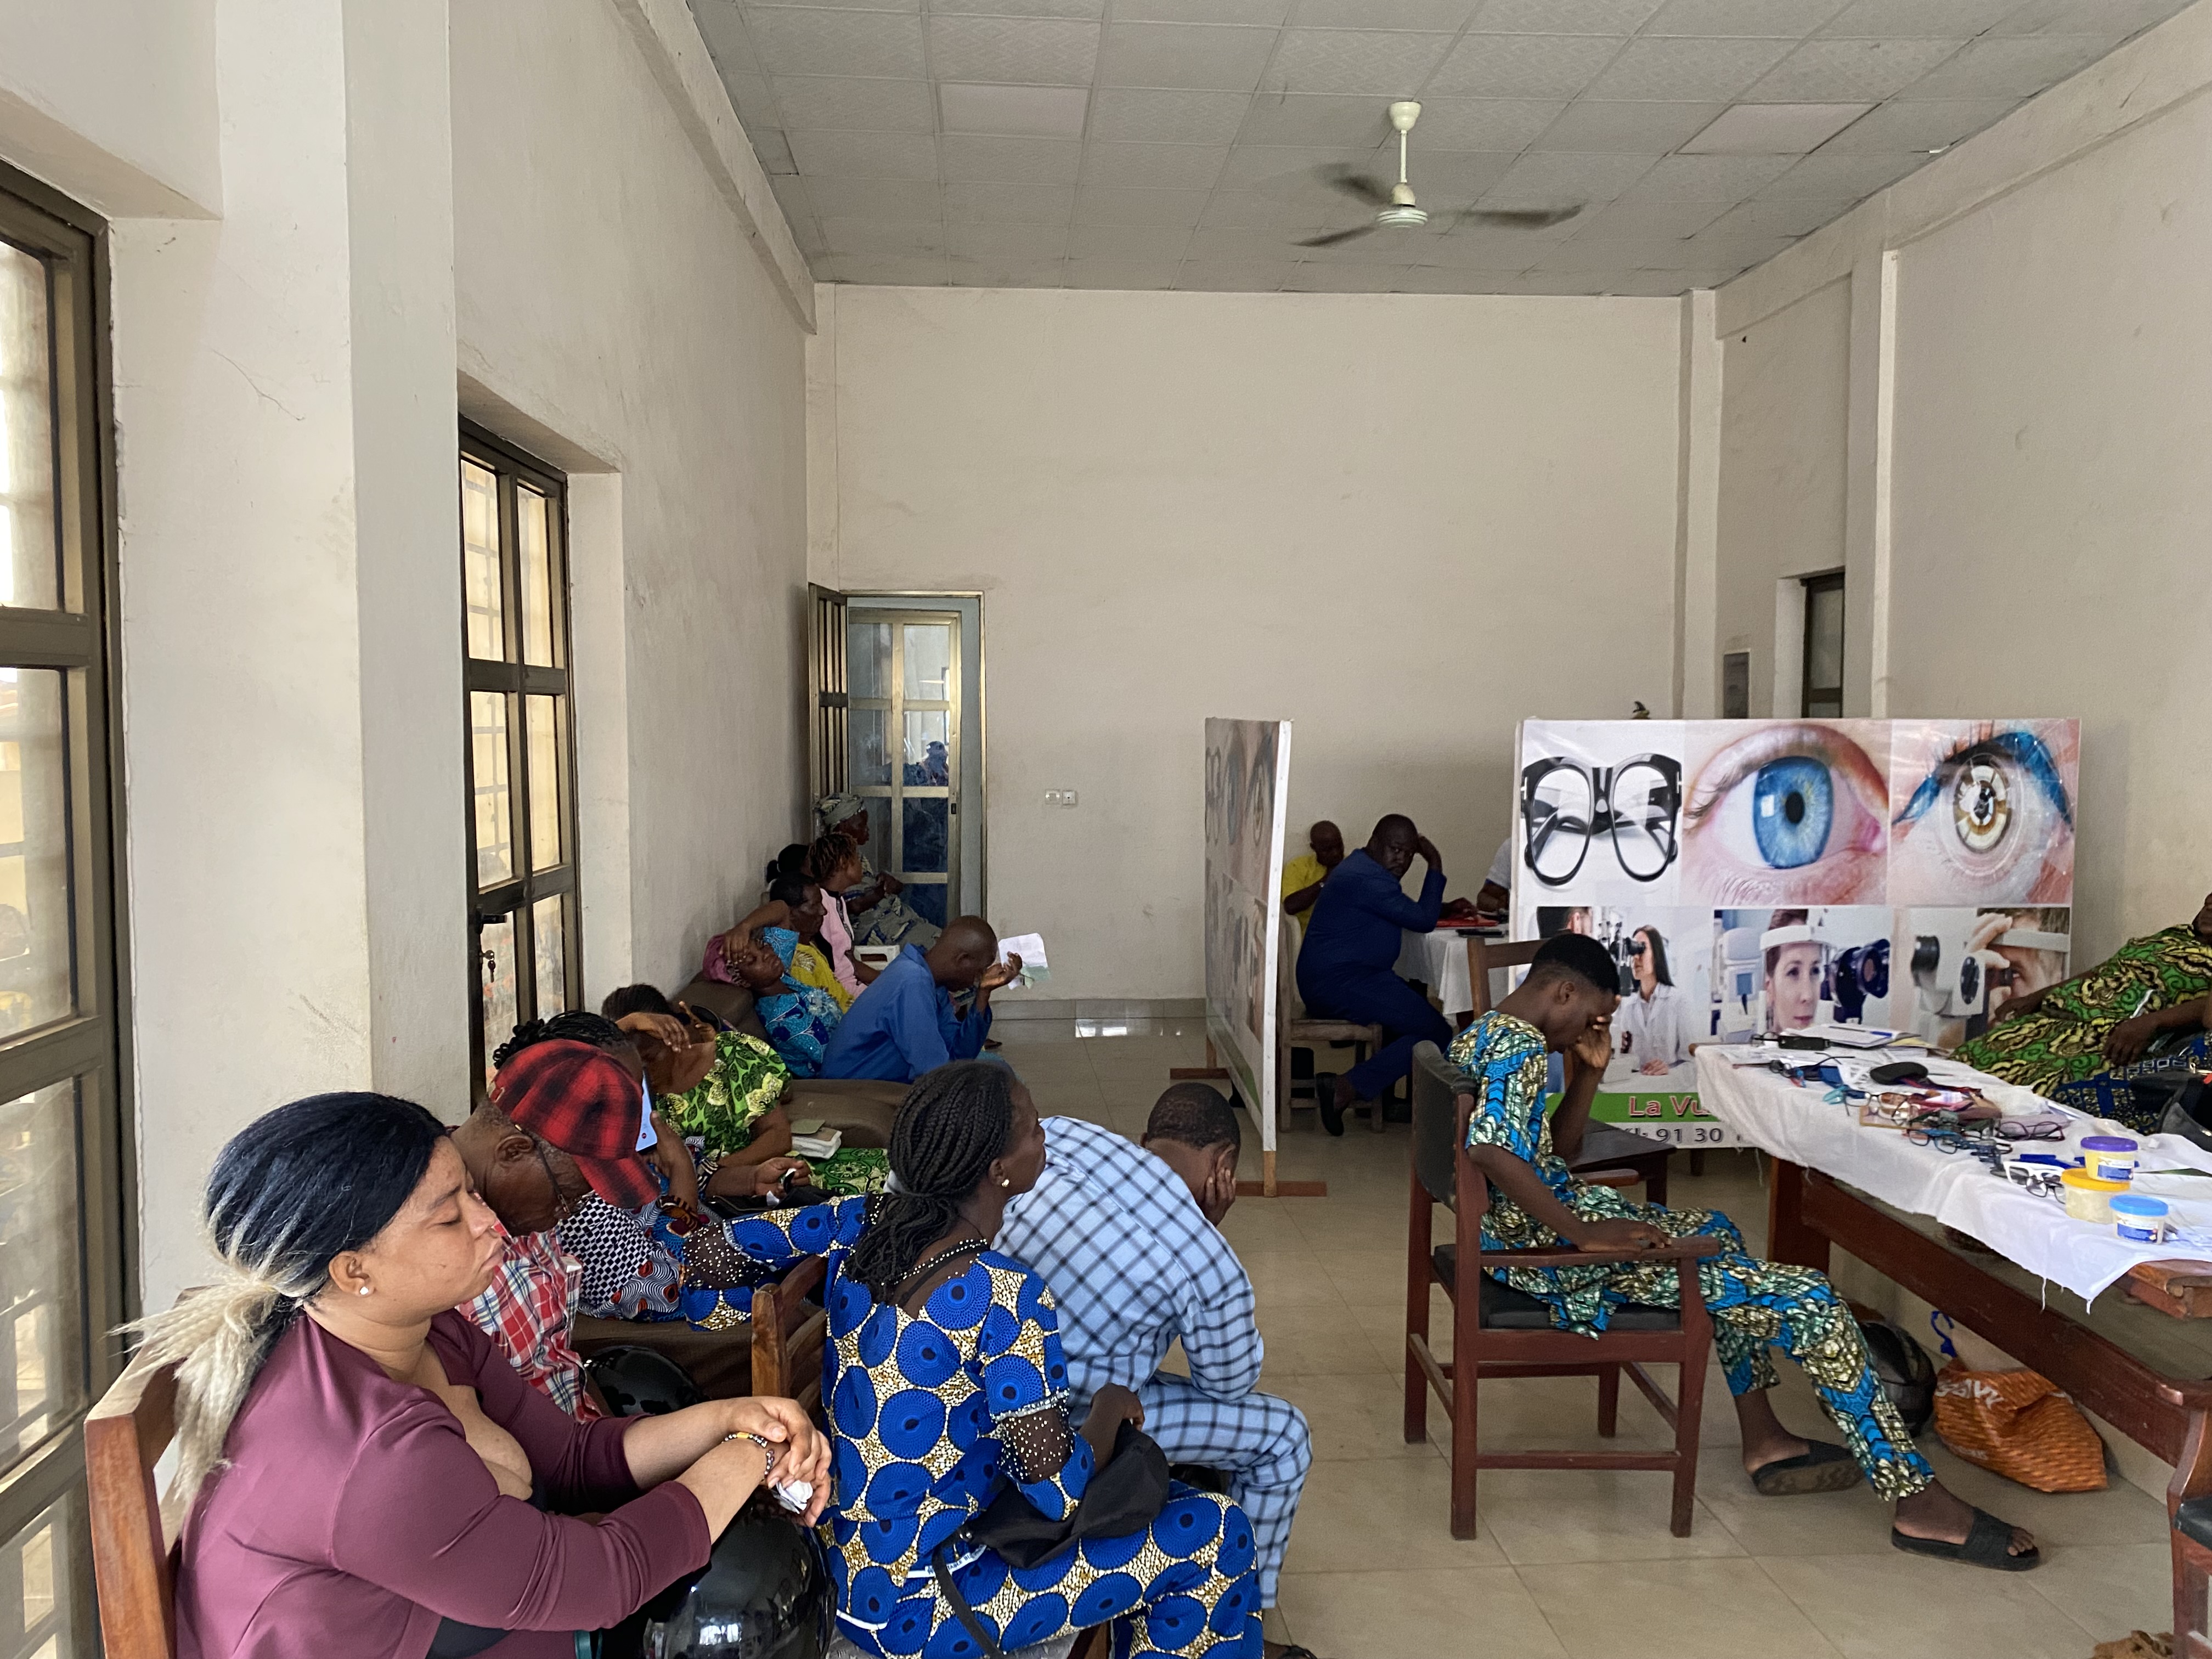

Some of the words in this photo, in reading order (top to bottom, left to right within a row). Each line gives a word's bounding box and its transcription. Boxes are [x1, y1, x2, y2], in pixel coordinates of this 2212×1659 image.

[1629, 1096, 1661, 1116] La
[1669, 1096, 1710, 1115] Vu
[1656, 1128, 1682, 1143] 91
[1694, 1128, 1723, 1142] 30
